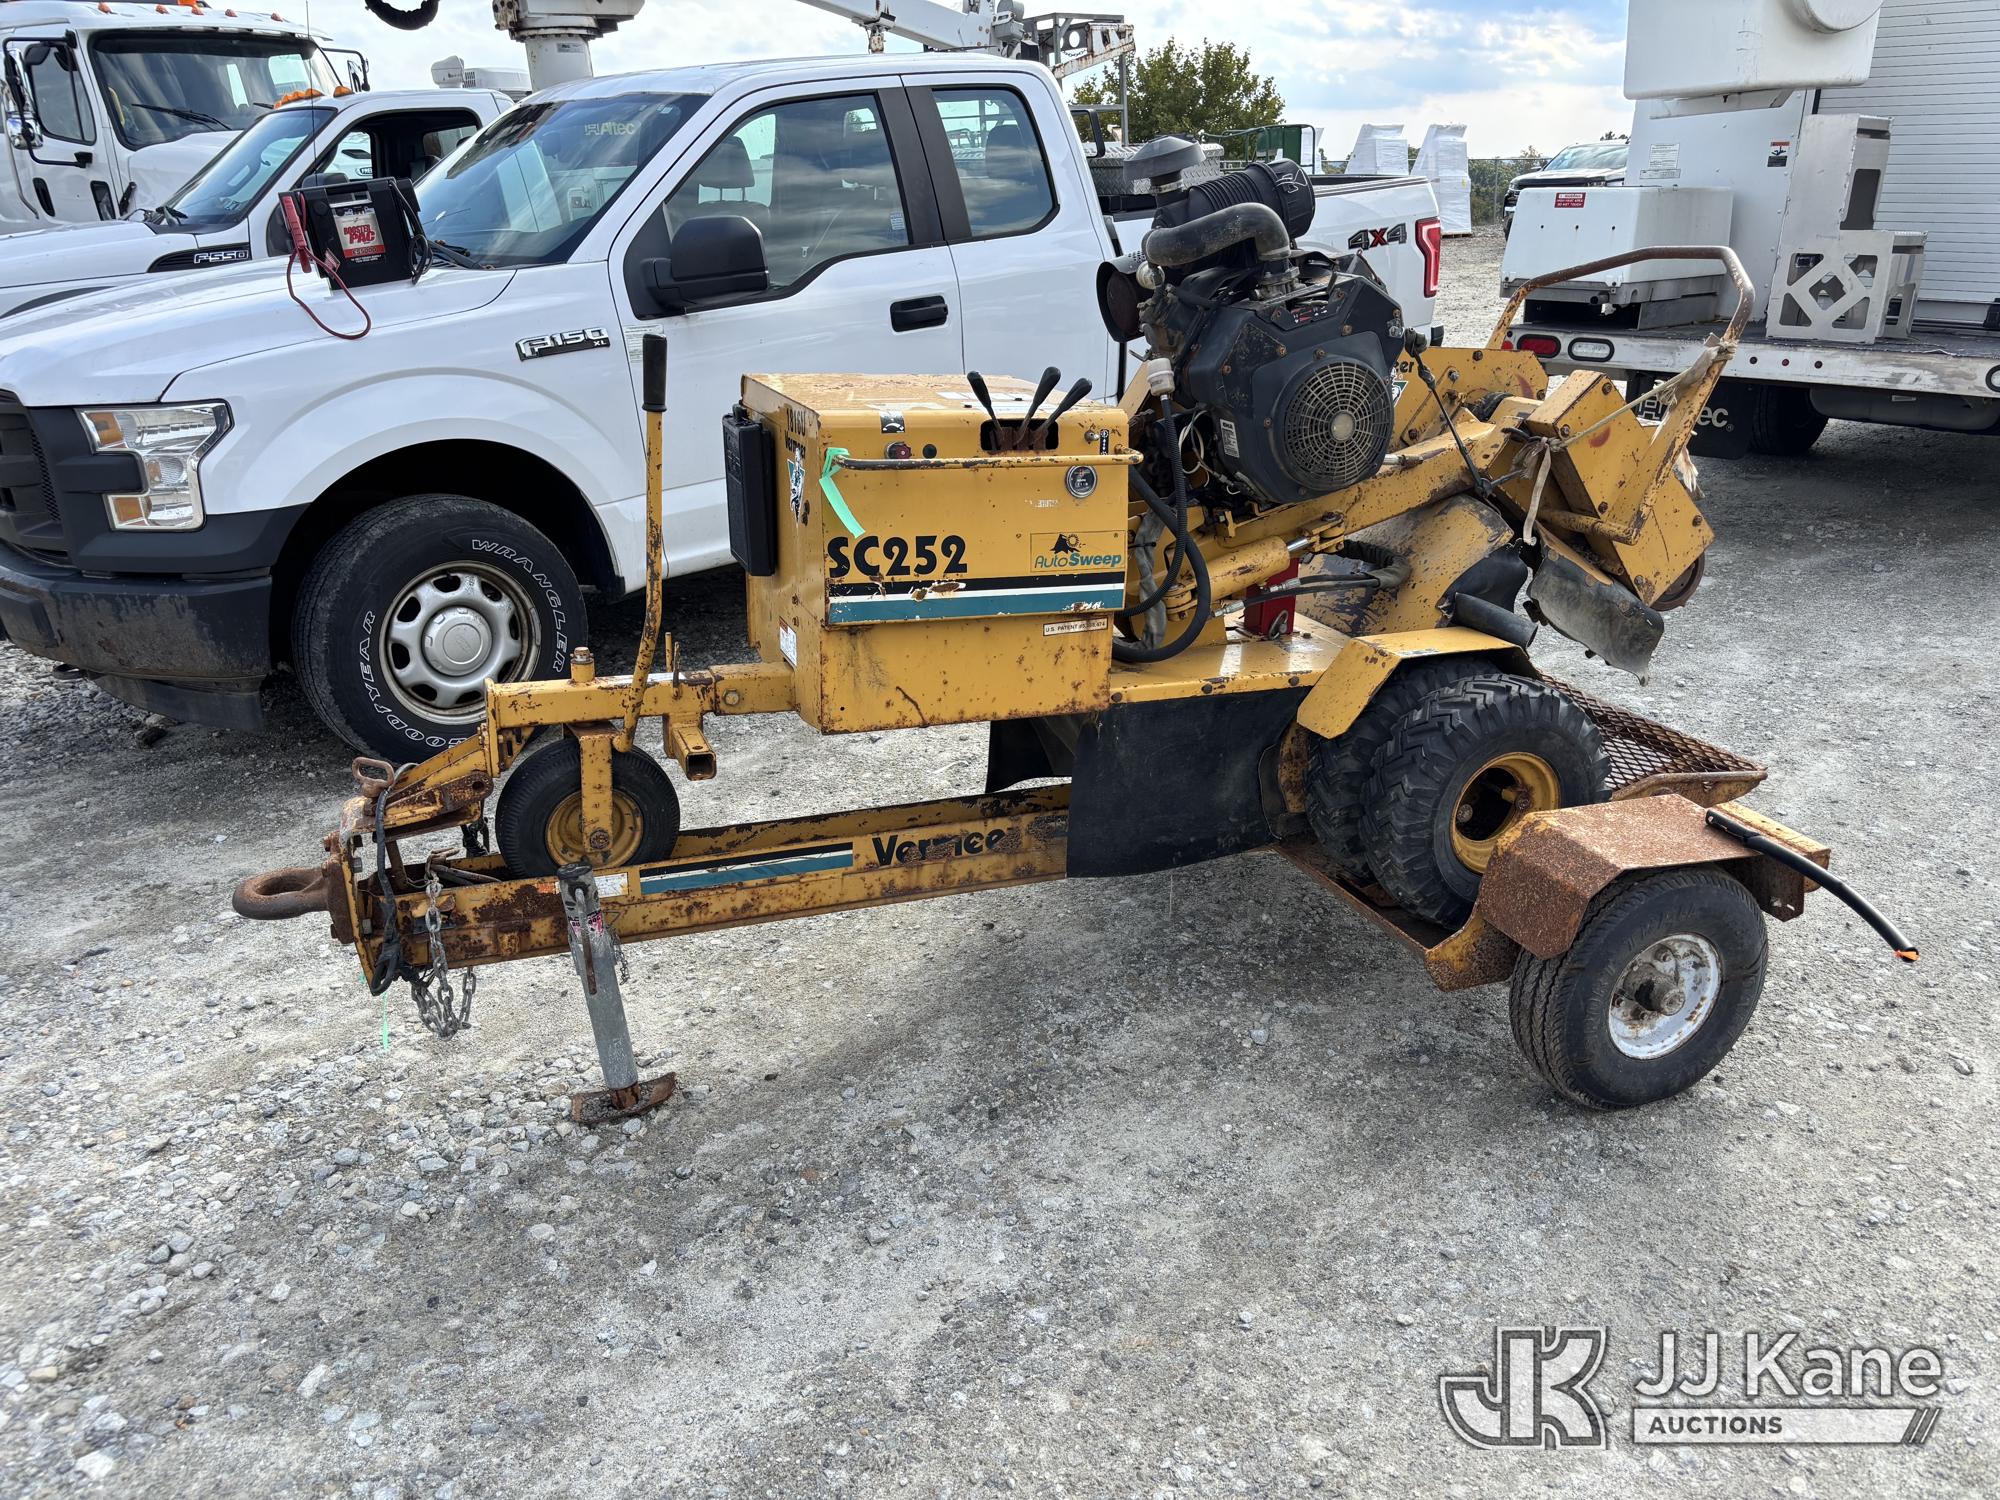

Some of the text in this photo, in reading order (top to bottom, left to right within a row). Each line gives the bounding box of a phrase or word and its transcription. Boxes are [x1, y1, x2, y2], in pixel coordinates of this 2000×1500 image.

[349, 230, 376, 244] PAC
[828, 535, 968, 578] SC252
[471, 539, 568, 673] WRANGLER
